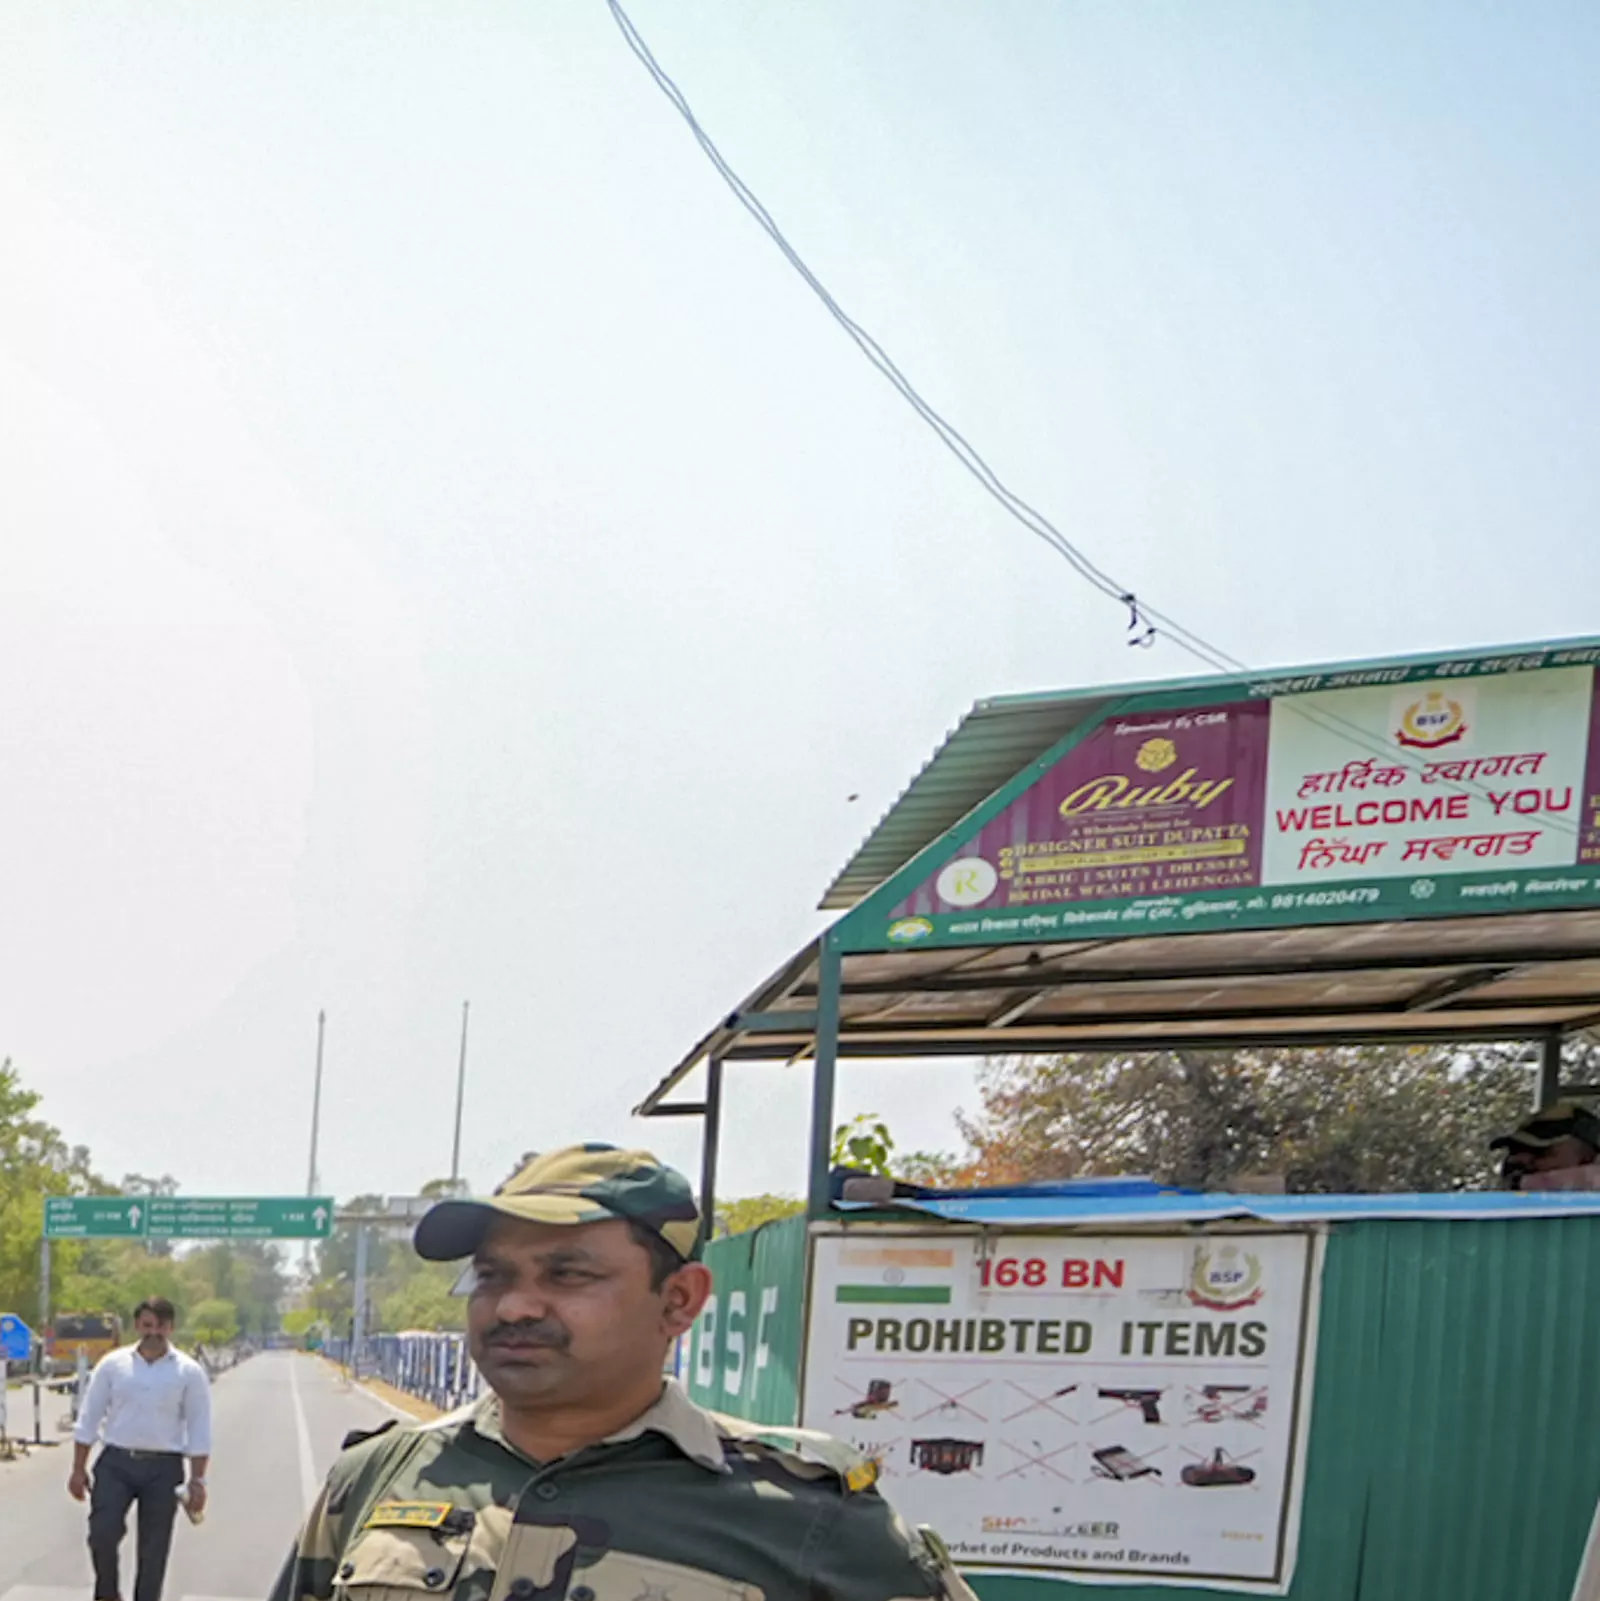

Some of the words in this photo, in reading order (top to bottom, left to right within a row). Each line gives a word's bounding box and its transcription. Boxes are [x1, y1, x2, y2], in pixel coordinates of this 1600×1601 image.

[1415, 713, 1449, 727] BSF
[1297, 757, 1408, 798] हार्दिक
[1419, 751, 1549, 785] स्वागत
[1058, 767, 1235, 817] Ruby
[1275, 794, 1471, 833] WELCOME
[1486, 786, 1573, 816] YOU
[1013, 837, 1109, 857] DESIGNER
[1112, 831, 1158, 848] SUIT
[1163, 823, 1252, 844] DUPATTA
[1400, 829, 1545, 862] ਸਵਾਗਤ
[1008, 886, 1074, 904] BRIDAL
[1079, 882, 1133, 897] WEAR
[1151, 871, 1255, 892] LEHENGAS
[1013, 872, 1077, 888] FABRIC
[1095, 865, 1151, 882] SUITS
[1169, 858, 1250, 875] DRESSES
[976, 1258, 1048, 1288] 168
[1060, 1258, 1127, 1289] BN
[846, 1317, 1093, 1356] PROHIBTED
[1119, 1320, 1268, 1358] ITEMS
[947, 1540, 987, 1554] arket
[989, 1541, 1009, 1555] of
[1011, 1542, 1088, 1560] Products
[1091, 1546, 1126, 1562] and
[1128, 1548, 1192, 1566] Brands
